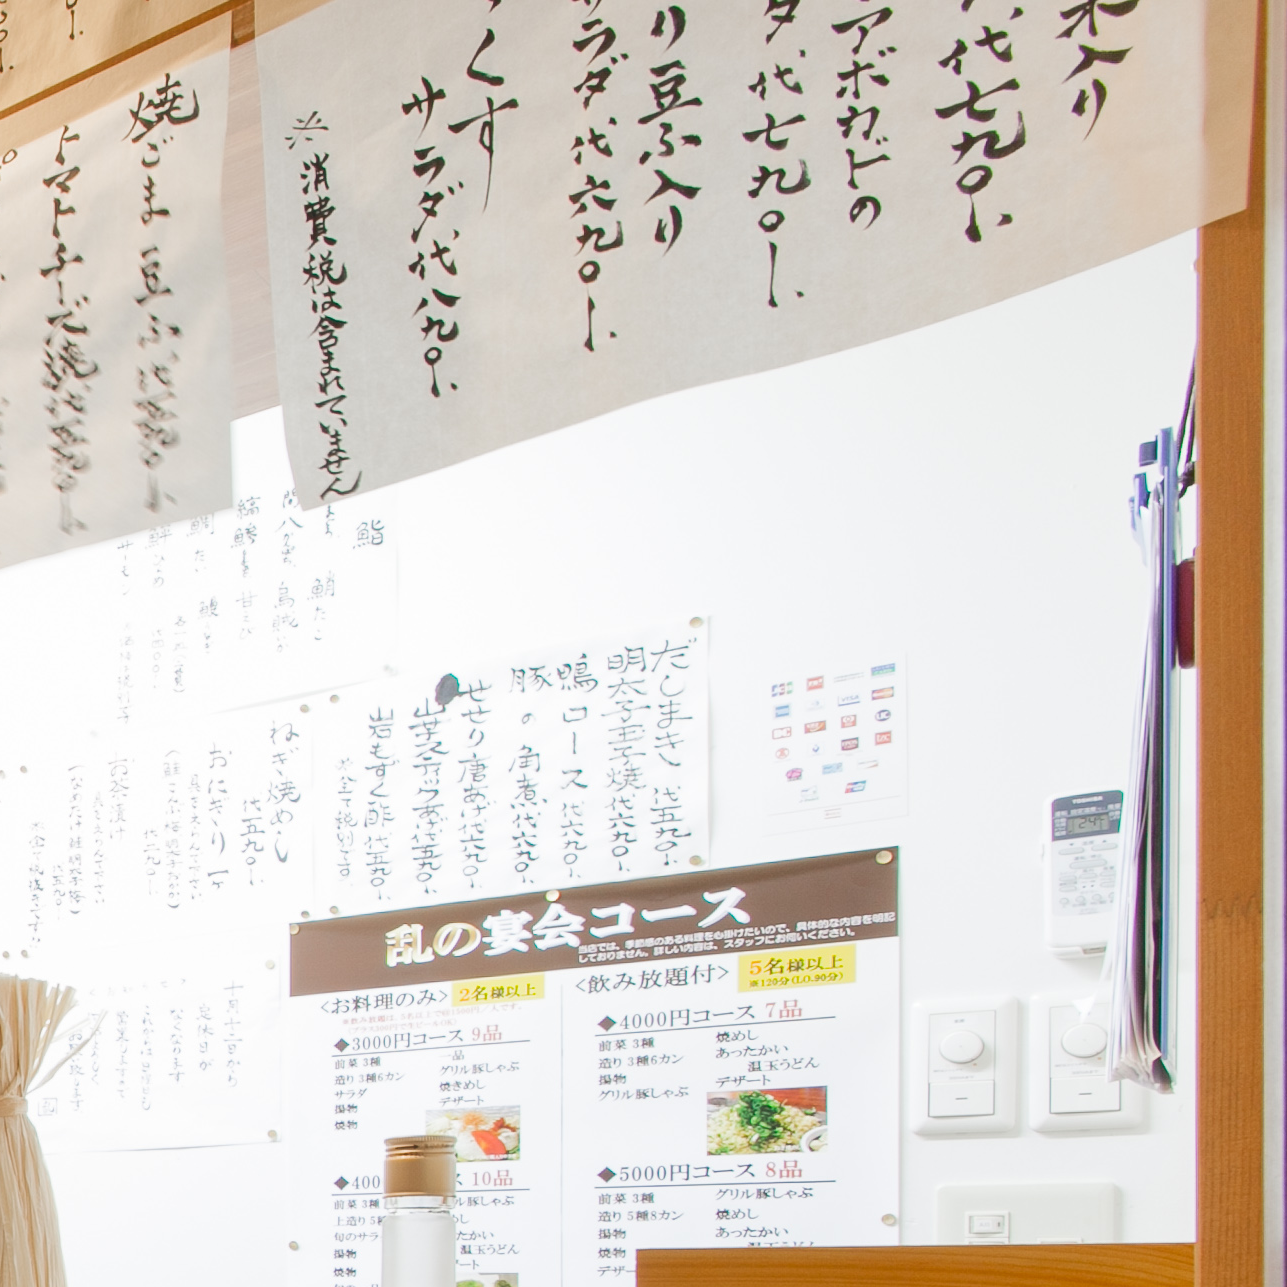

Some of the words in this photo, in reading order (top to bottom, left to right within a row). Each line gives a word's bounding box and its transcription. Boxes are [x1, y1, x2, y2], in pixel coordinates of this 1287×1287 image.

[385, 886, 752, 968] 乱の宴会コース
[749, 955, 844, 975] 5名様以上
[459, 984, 536, 1003] 2名様以上
[765, 999, 803, 1019] 7品
[471, 1024, 503, 1042] 9品
[715, 1044, 788, 1059] あったかい
[715, 1075, 771, 1088] デザート
[334, 1088, 368, 1099] サラダ
[765, 1159, 803, 1179] 8品
[472, 1170, 513, 1187] 10品
